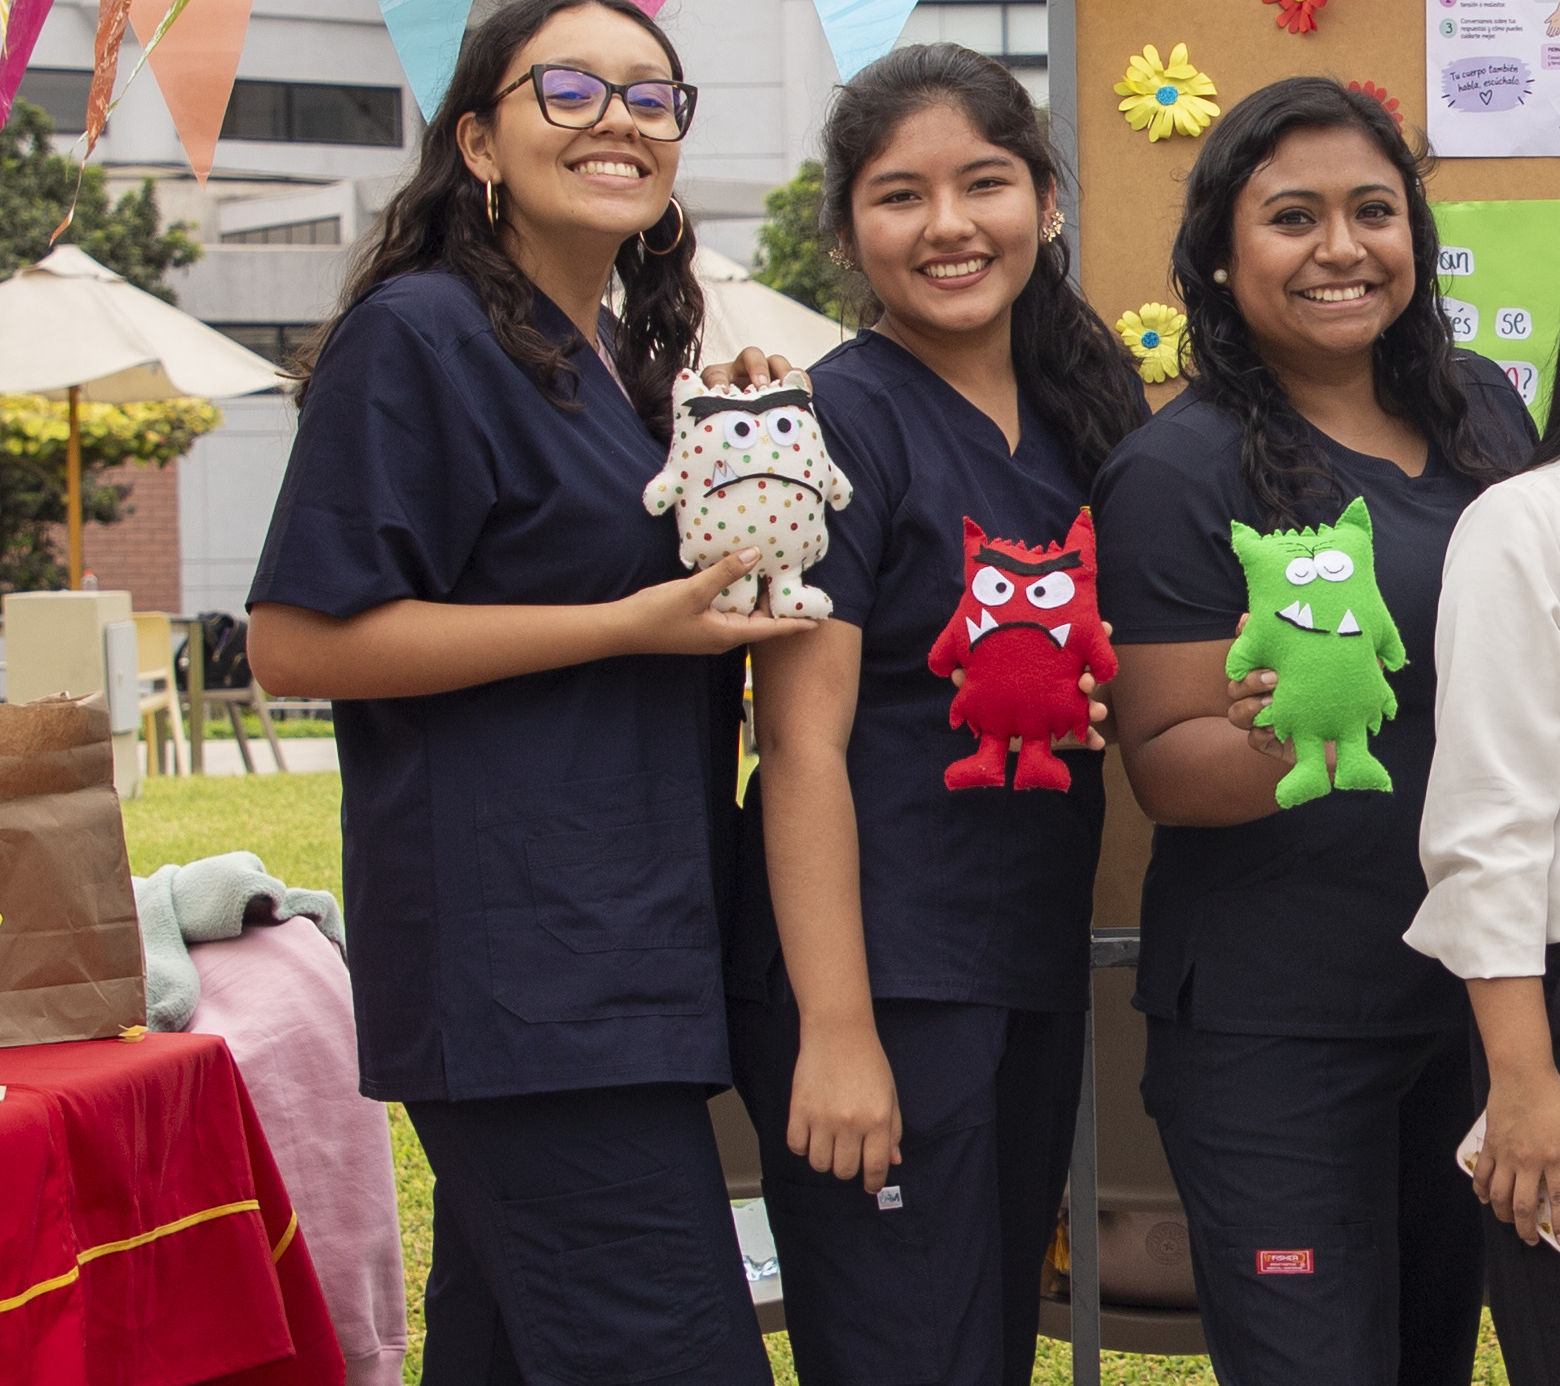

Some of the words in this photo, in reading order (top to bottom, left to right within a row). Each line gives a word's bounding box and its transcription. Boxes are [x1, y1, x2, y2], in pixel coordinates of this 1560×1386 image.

[1445, 23, 1453, 34] 3
[1450, 71, 1460, 81] Tu
[1462, 68, 1486, 79] cuerpo
[1488, 63, 1519, 74] también
[1502, 313, 1526, 335] se
